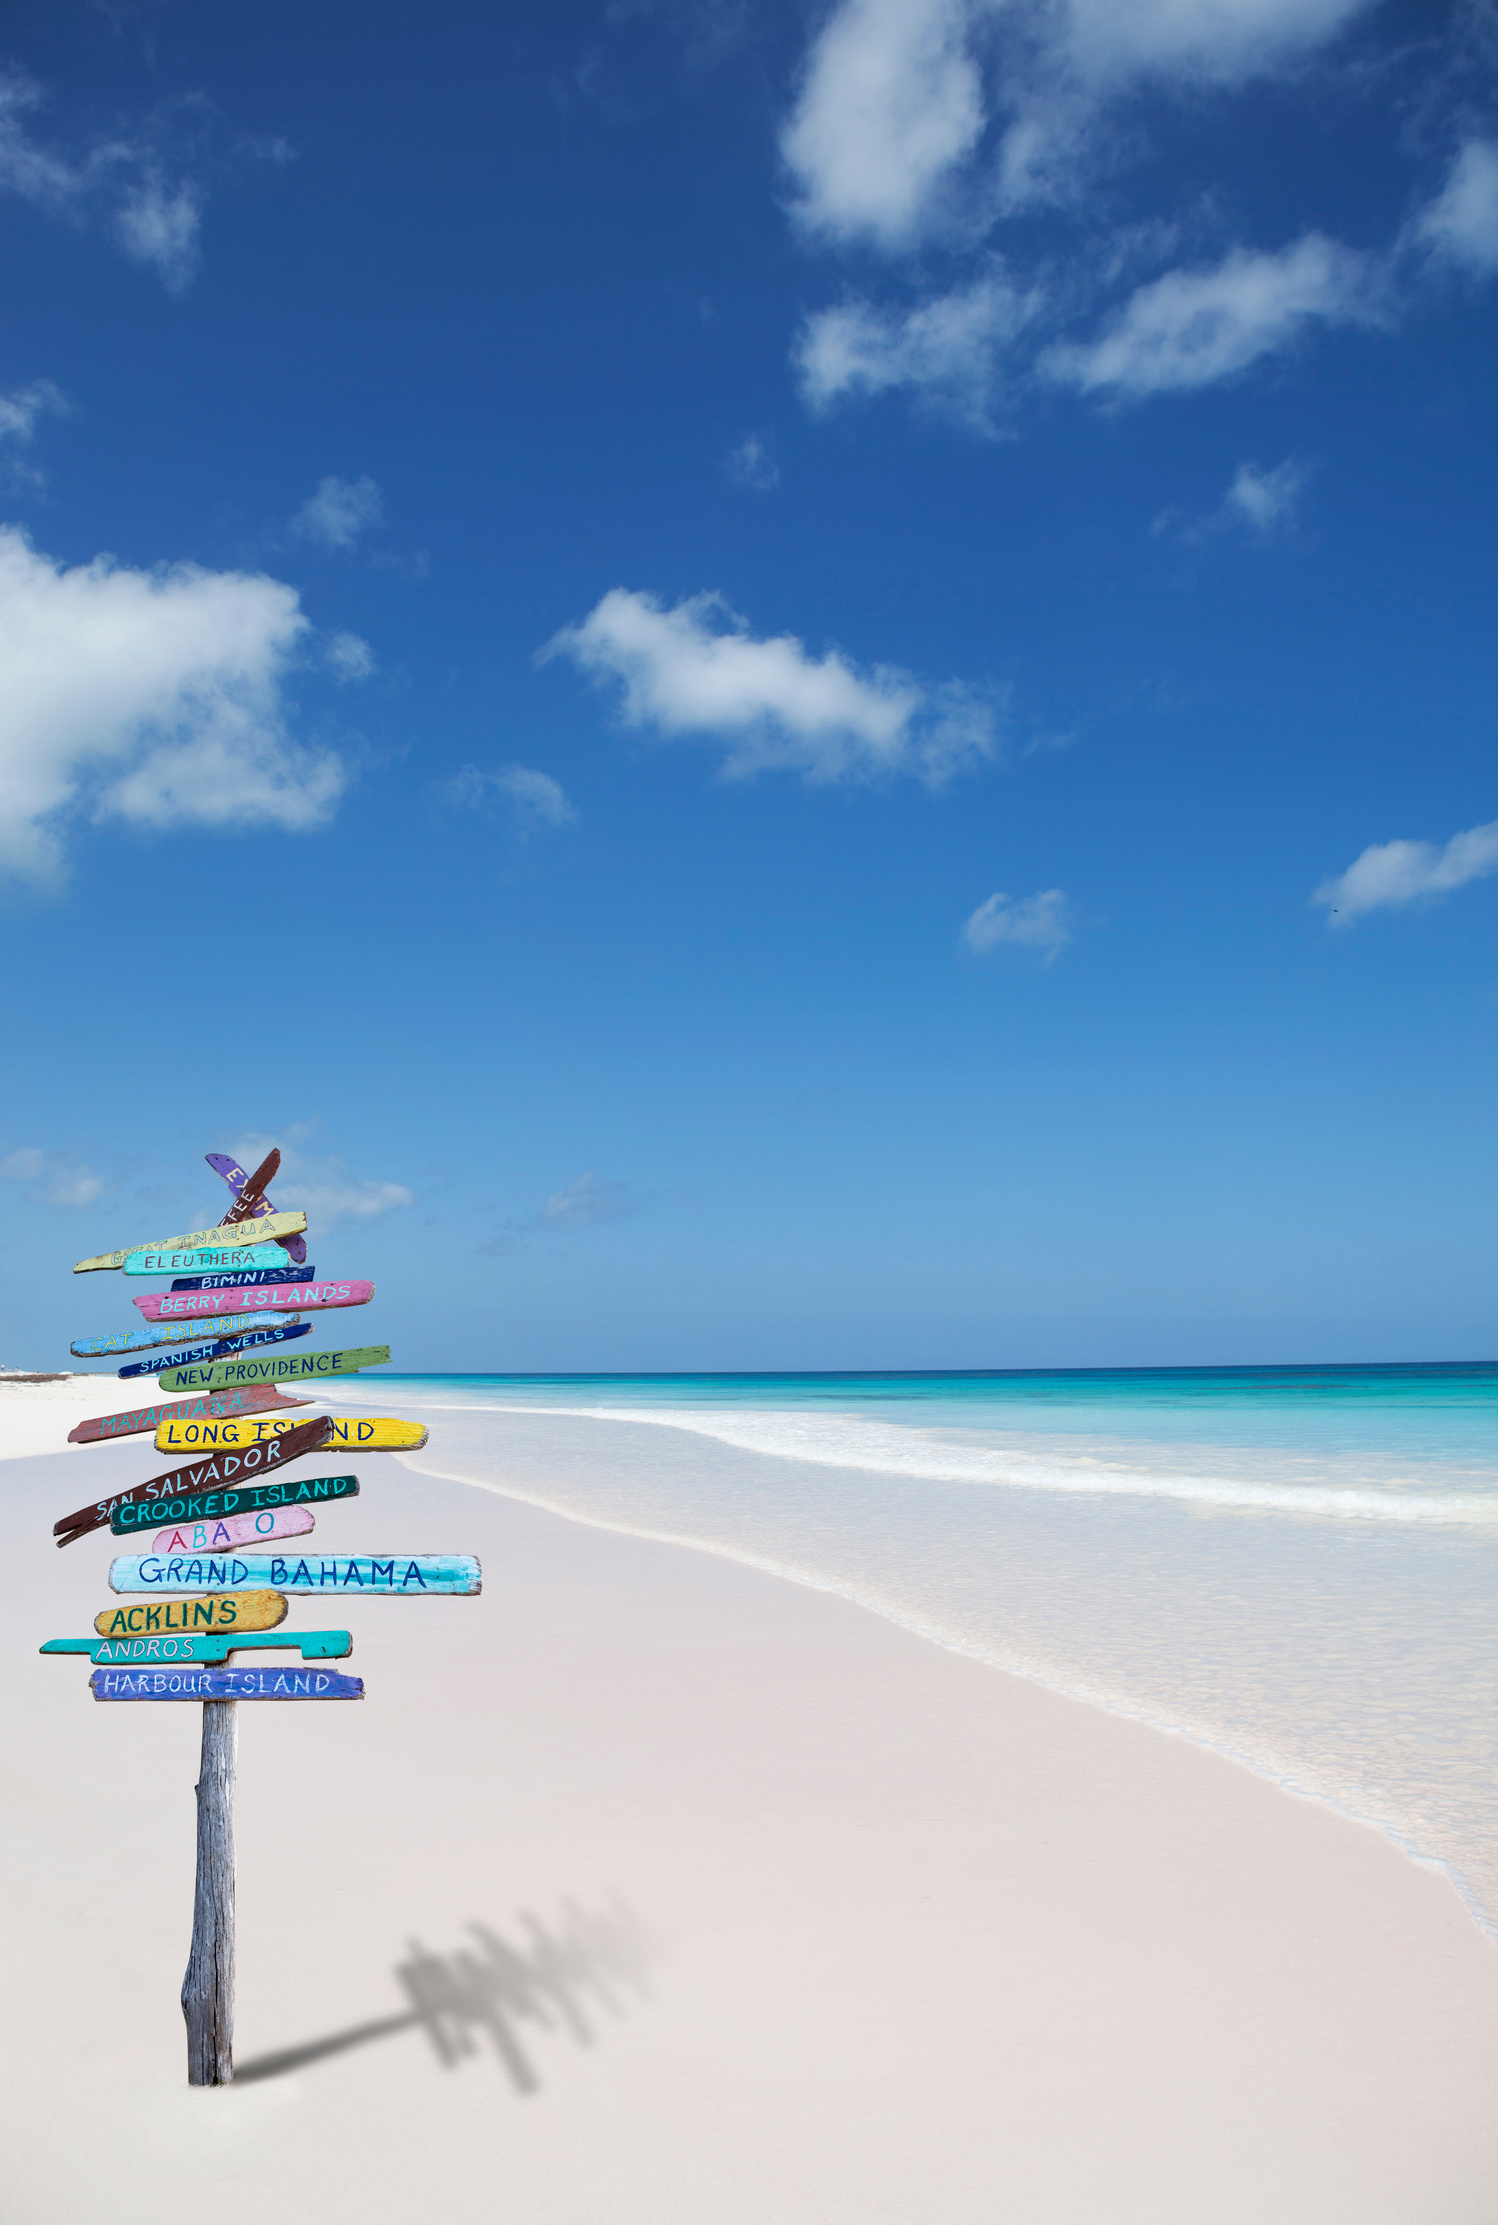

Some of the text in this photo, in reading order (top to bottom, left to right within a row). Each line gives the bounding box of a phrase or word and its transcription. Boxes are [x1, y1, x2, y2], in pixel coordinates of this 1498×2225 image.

[177, 1218, 275, 1250] INAGUA
[145, 1252, 256, 1269] ELEUTHERA
[201, 1271, 265, 1289] BIMINI
[159, 1285, 351, 1313] BERRY ISLANDS
[91, 1314, 249, 1351] CAT ISLAND
[139, 1328, 285, 1373] SPANISH WELLS
[176, 1352, 344, 1386] NEW PROVIDENCE
[100, 1391, 245, 1436] MAYAGUANA
[167, 1424, 240, 1443] LONG
[145, 1440, 281, 1501] SALVADOR
[120, 1477, 347, 1524] CROOKED ISLAND
[138, 1557, 427, 1588] GRAND BAHAMA
[110, 1599, 237, 1634] ACKLINS
[95, 1638, 195, 1659] ANDROS
[104, 1672, 330, 1694] HARBOUR ISLAND
